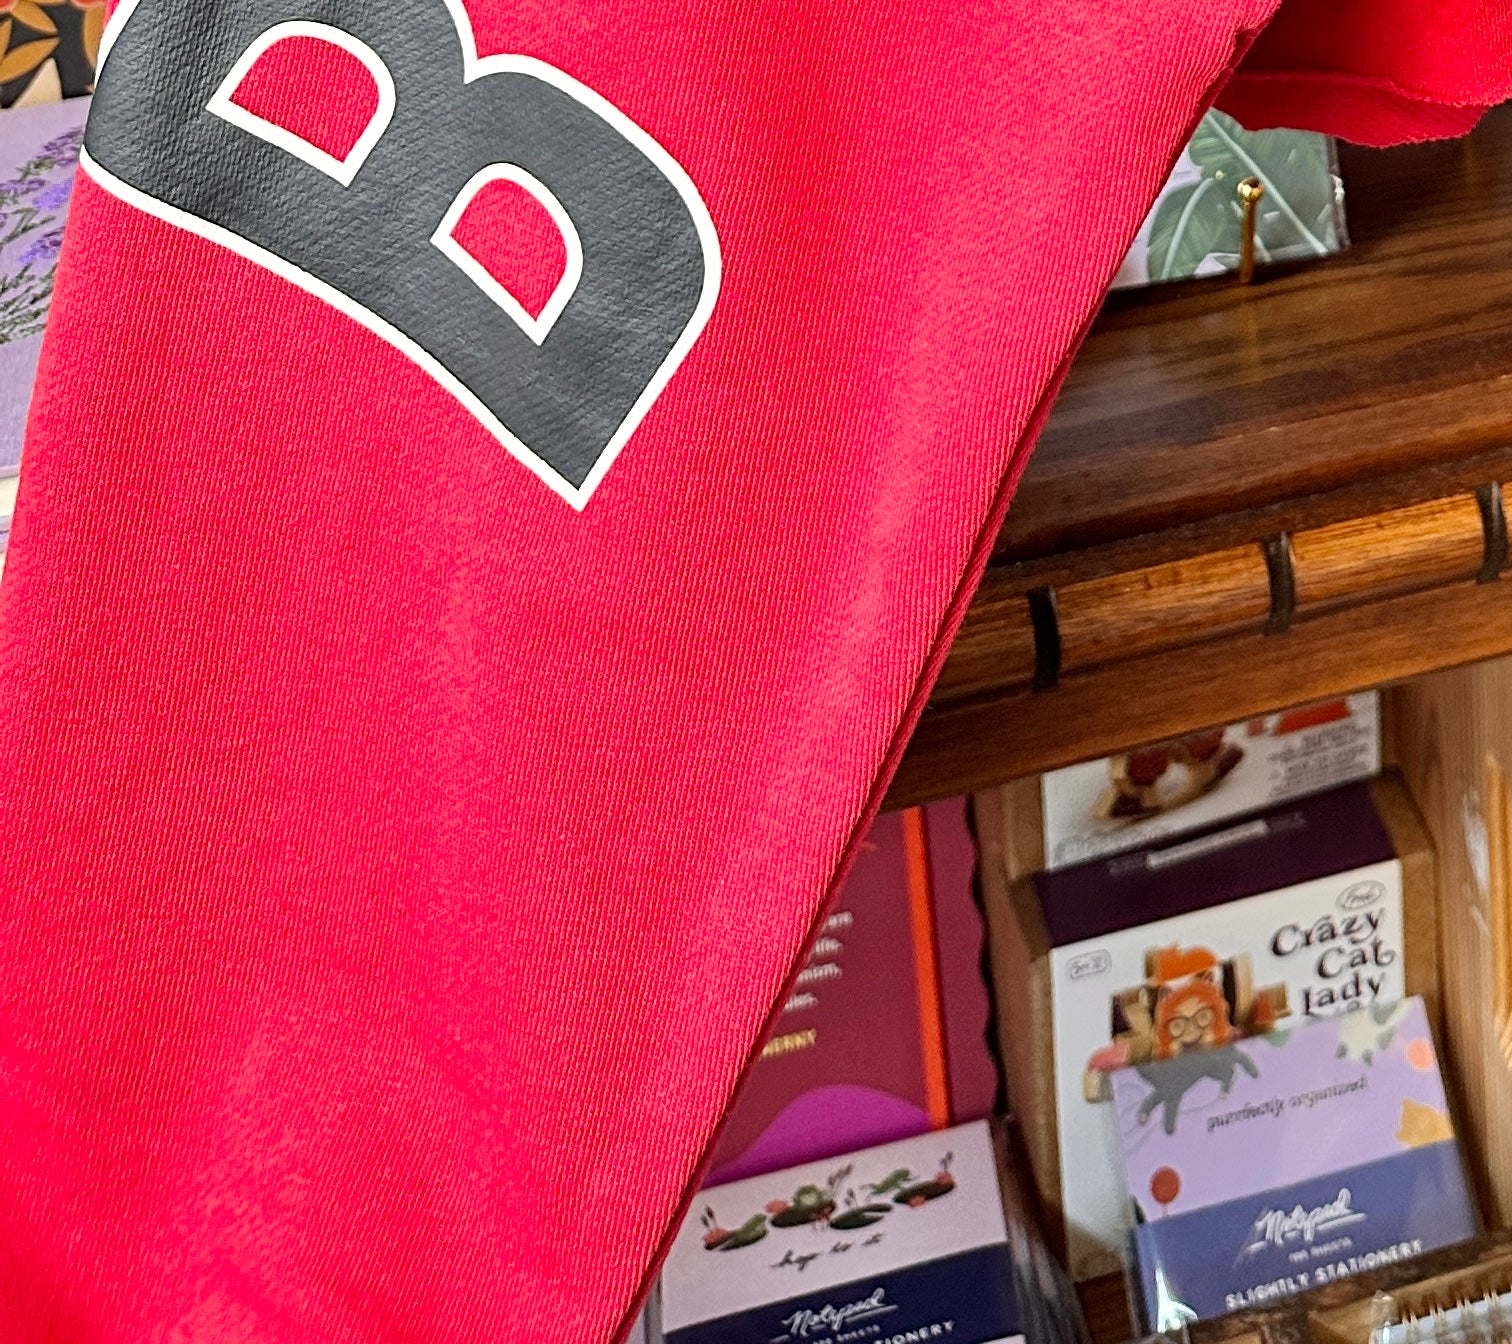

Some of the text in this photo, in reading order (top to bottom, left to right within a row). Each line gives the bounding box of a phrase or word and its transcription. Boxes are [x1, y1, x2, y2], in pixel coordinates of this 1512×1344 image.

[1271, 908, 1384, 956] Crazy
[1318, 938, 1396, 979] Cat
[1303, 971, 1382, 1016] Lady
[1224, 1238, 1424, 1310] SLIGHTLY STATIONERY
